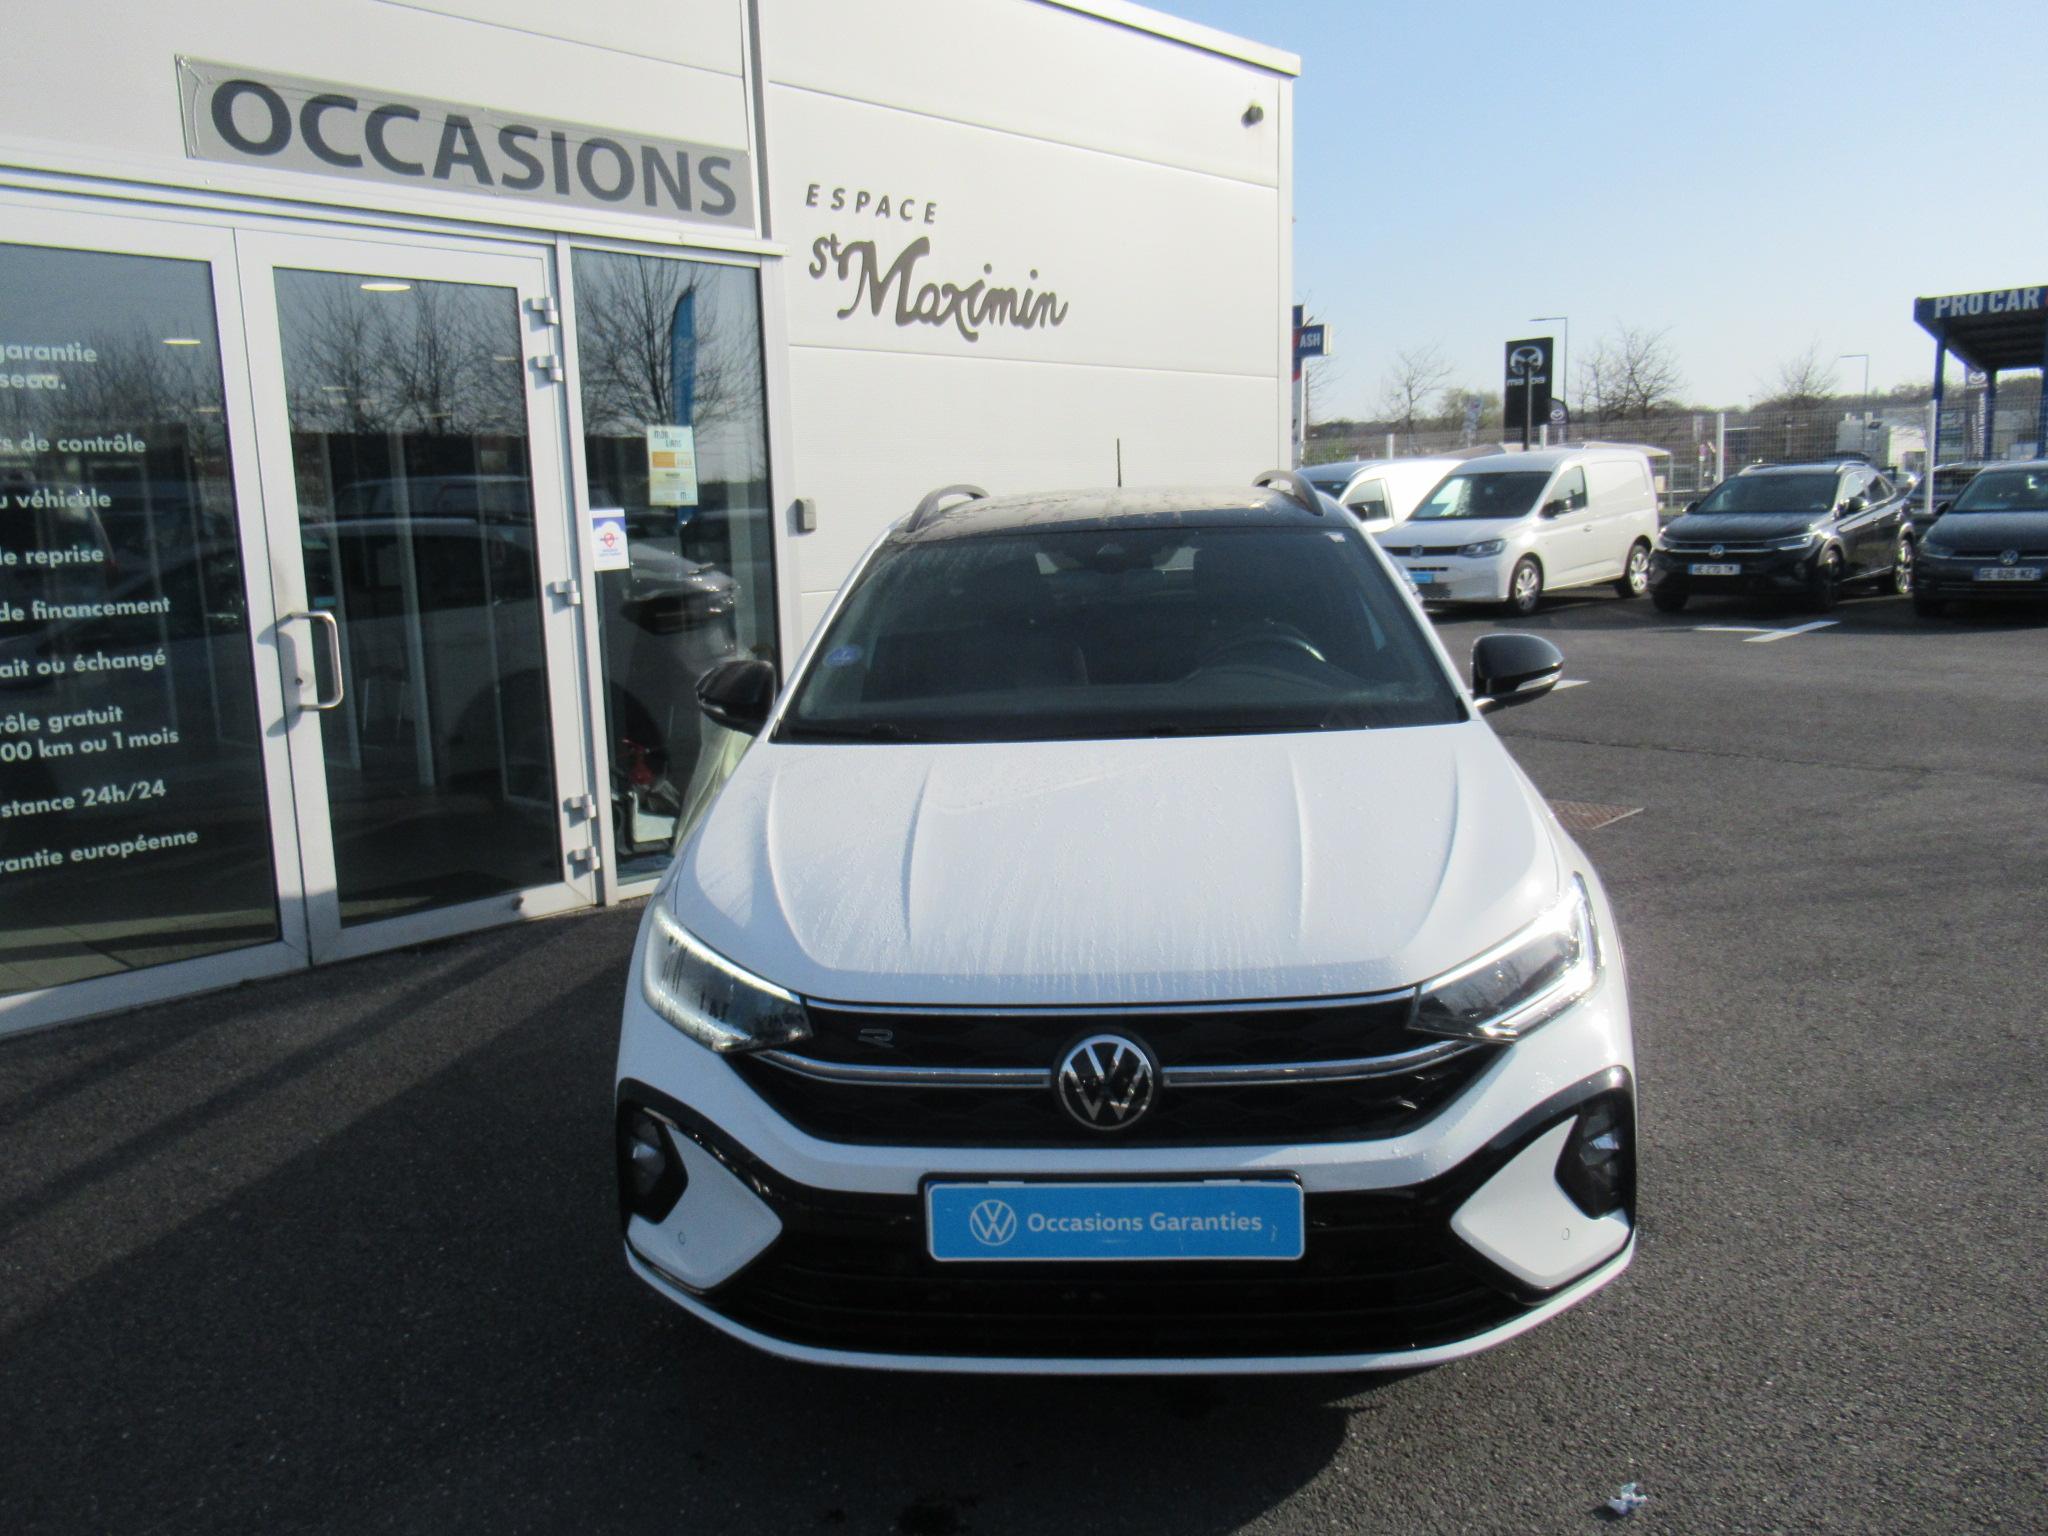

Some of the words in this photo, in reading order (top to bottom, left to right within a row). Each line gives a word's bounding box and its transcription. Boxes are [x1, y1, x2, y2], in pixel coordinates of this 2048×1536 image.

[211, 79, 737, 217] OCCASIONS
[806, 183, 937, 224] ESPACE
[837, 236, 1069, 342] Maximin
[1934, 293, 1984, 319] PRO
[1988, 287, 2041, 313] CAR
[21, 431, 50, 453] de
[57, 432, 146, 453] contrôle
[16, 487, 112, 509] véhicule
[0, 547, 18, 566] e
[25, 545, 104, 568] reprise
[32, 597, 170, 620] financement
[36, 660, 66, 675] ou
[73, 648, 167, 672] échangé
[48, 705, 124, 733] gratuit
[38, 738, 74, 758] km
[80, 738, 107, 753] ou
[112, 731, 123, 749] 1
[128, 727, 179, 748] mois
[0, 796, 76, 818] stance
[82, 779, 166, 807] 24h/24
[70, 831, 199, 859] européenne
[1026, 1211, 1144, 1233] Occasions
[1149, 1211, 1263, 1232] Garanties
